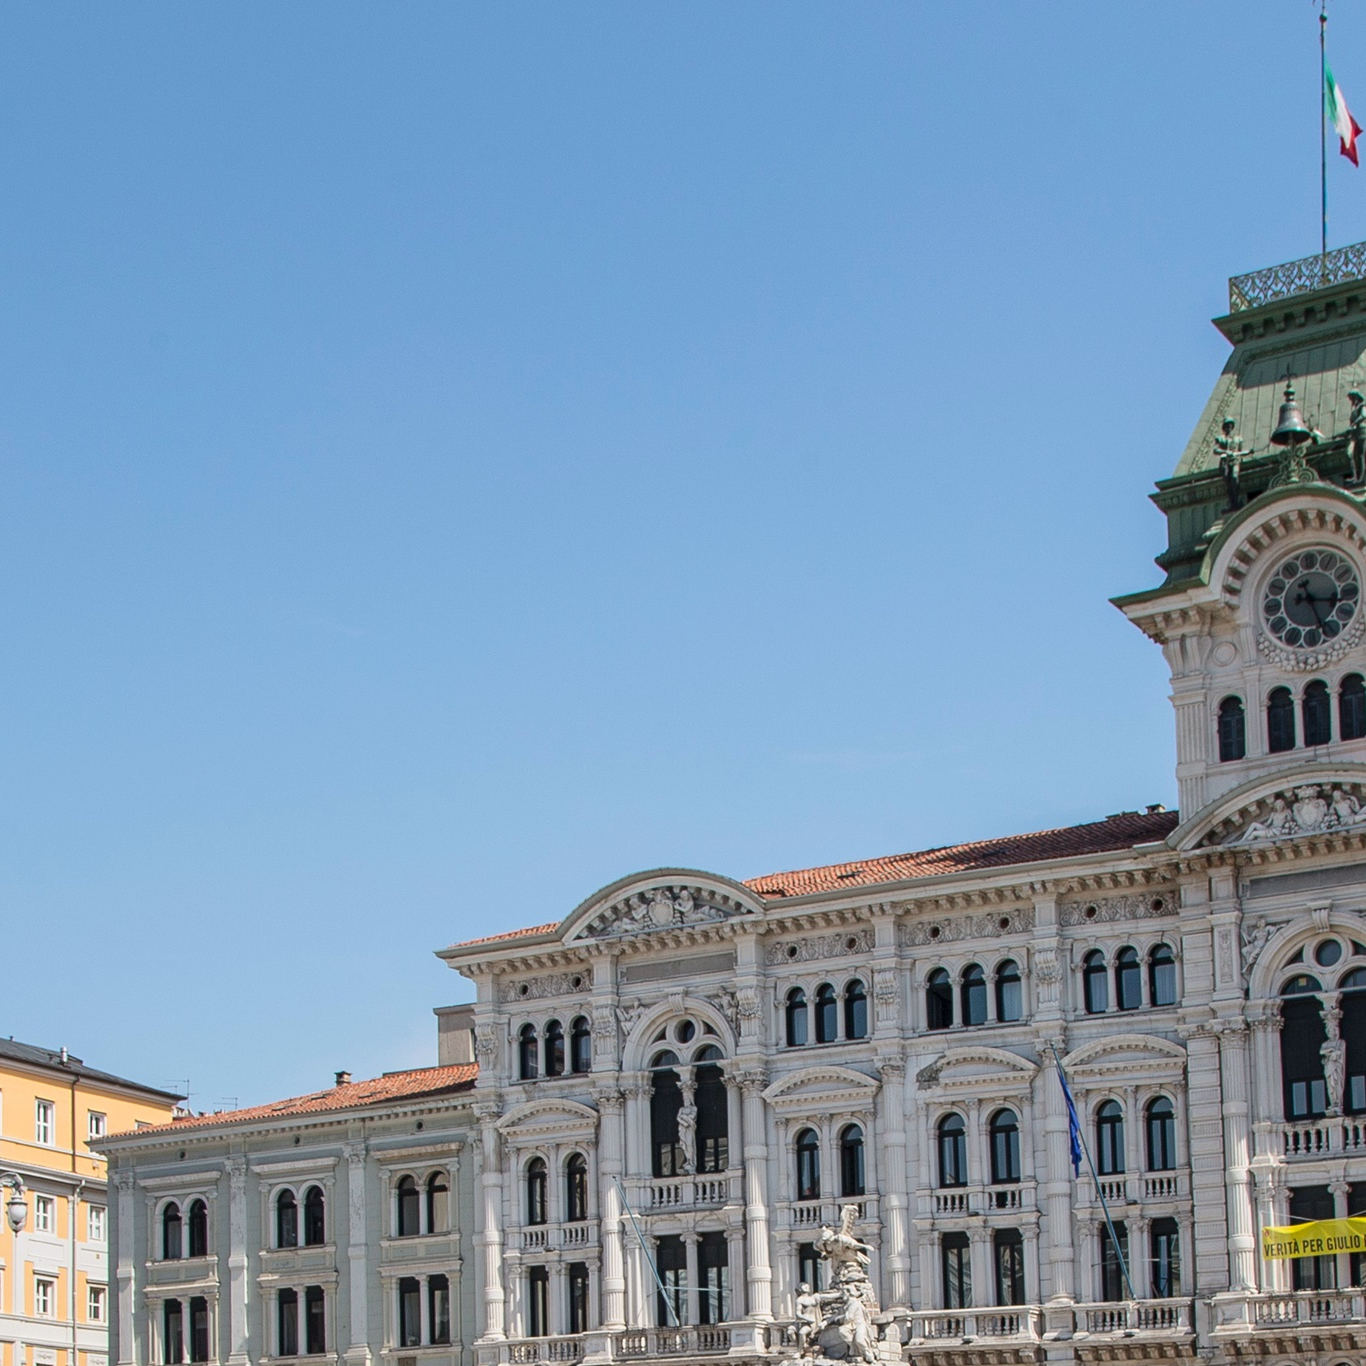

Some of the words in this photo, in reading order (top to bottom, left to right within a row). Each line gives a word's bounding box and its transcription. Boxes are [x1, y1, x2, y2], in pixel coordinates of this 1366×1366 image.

[1263, 1238, 1300, 1257] VERITÀ
[1303, 1238, 1324, 1254] PER
[1326, 1234, 1361, 1251] GIULIO
